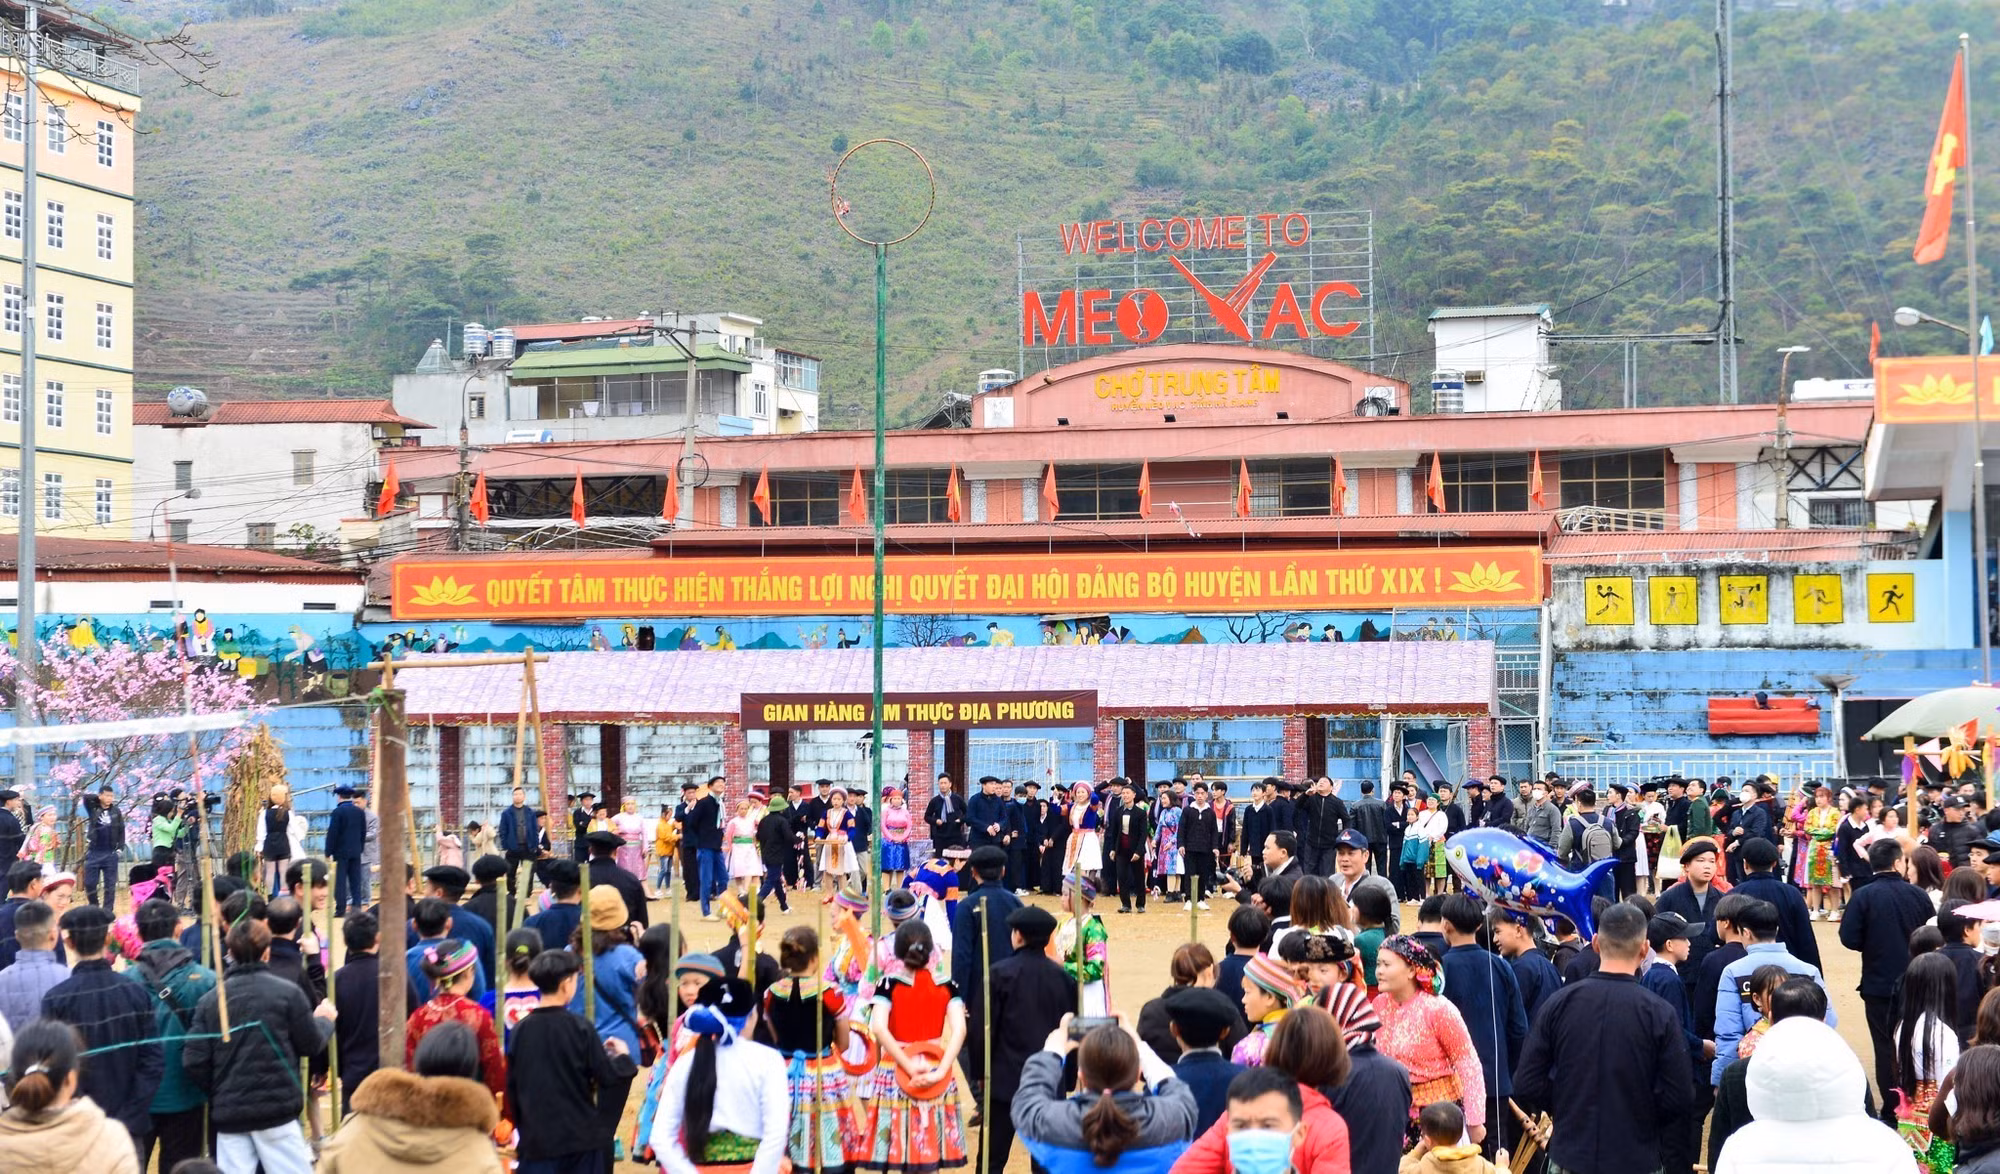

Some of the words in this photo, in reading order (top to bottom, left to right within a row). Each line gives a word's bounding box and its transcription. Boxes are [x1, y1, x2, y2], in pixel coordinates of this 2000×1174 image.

[1060, 214, 1246, 254] WELCOME
[1257, 213, 1310, 247] TO
[1148, 371, 1229, 397] TRUNG
[1233, 363, 1281, 394] TÂM
[486, 570, 553, 607] QUYẾT
[559, 573, 605, 603] TÂM
[612, 574, 668, 608] THỰC
[674, 571, 724, 608] HIỆN
[731, 566, 802, 601] THẮNG
[809, 573, 843, 606] LỢI
[909, 566, 979, 603] QUYẾT
[986, 573, 1024, 605] ĐẠI
[1032, 567, 1069, 605] HỘI
[1076, 564, 1139, 599] ĐẢNG
[1147, 566, 1178, 603] BỘ
[1184, 565, 1261, 603] HUYỆN
[1270, 561, 1317, 596] LẦN
[1325, 563, 1375, 595] THỨ
[1380, 567, 1426, 594] XIX
[1434, 567, 1442, 593] !
[763, 704, 808, 721] GIAN
[813, 701, 865, 721] HÀNG
[870, 704, 900, 721] M
[906, 702, 954, 724] THỰC
[959, 703, 992, 724] ĐỊA
[997, 700, 1075, 720] PHƯƠNG
